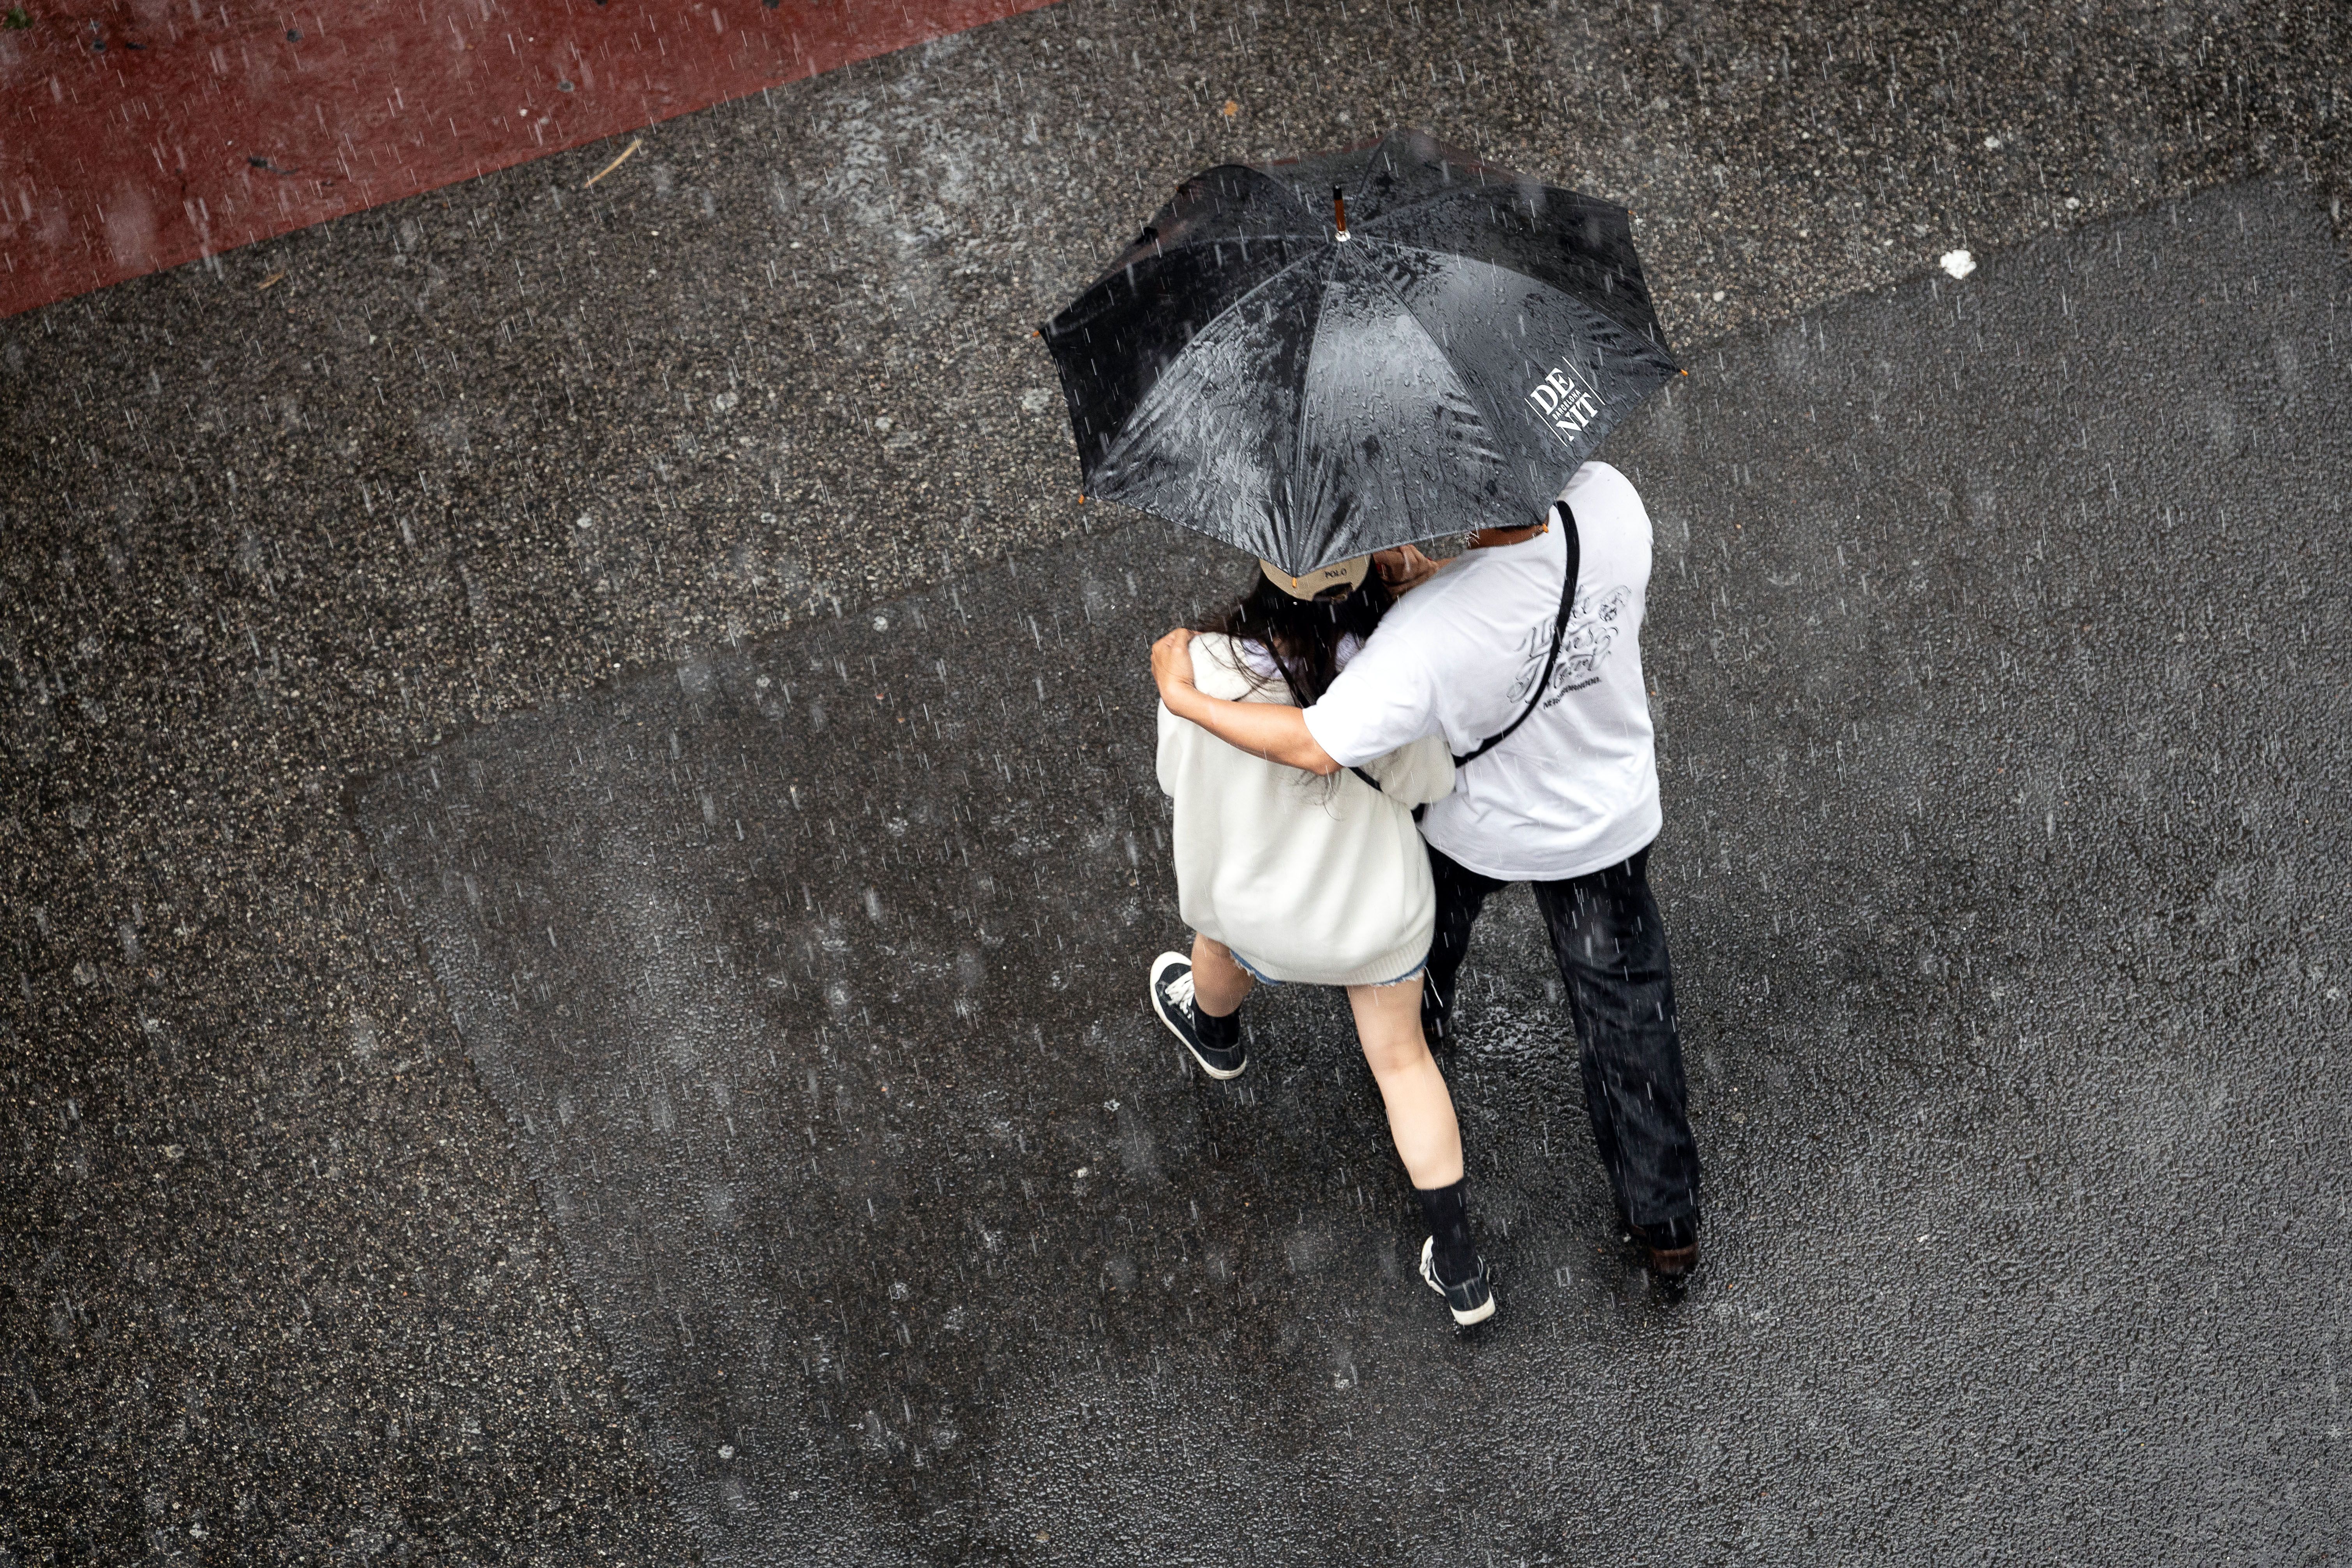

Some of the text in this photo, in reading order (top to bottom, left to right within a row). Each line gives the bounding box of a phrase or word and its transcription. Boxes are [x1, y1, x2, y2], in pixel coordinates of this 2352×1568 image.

[1530, 367, 1575, 416] DE
[1552, 389, 1582, 420] BARCELONA
[1556, 392, 1598, 442] NIT
